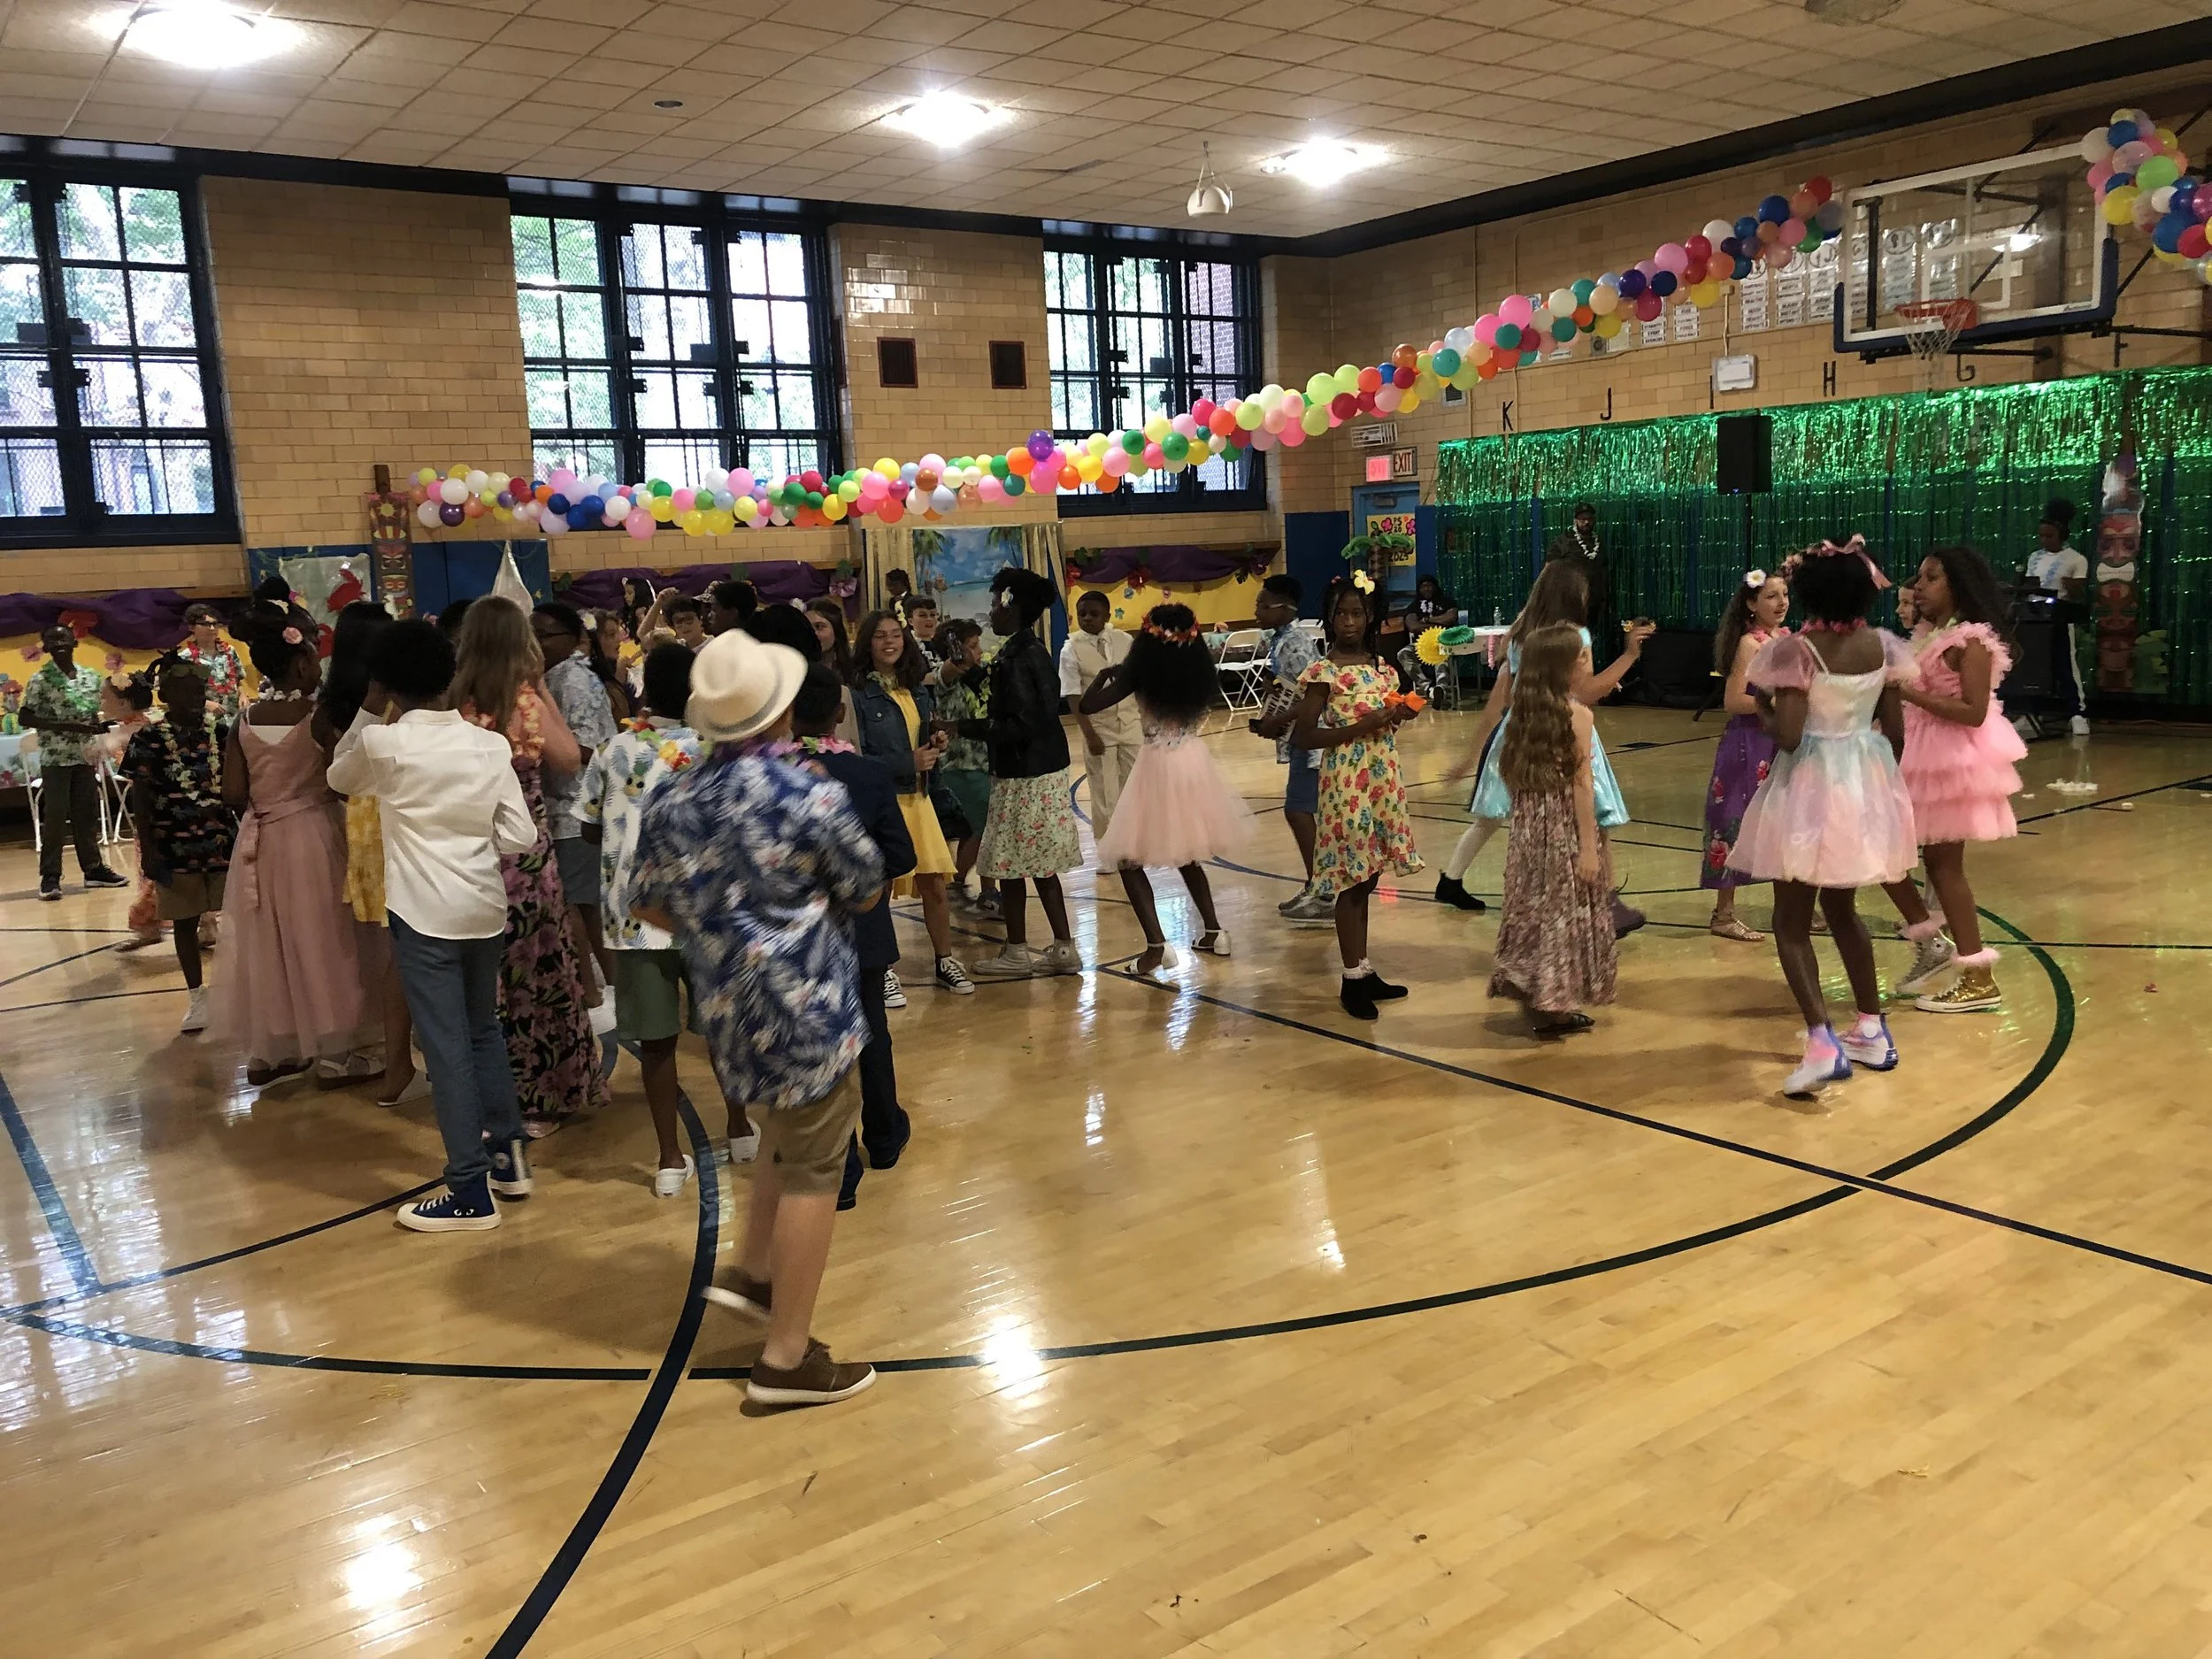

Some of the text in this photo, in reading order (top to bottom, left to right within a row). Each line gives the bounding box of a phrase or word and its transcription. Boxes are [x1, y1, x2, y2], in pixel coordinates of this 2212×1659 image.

[1823, 361, 1837, 397] H
[1502, 400, 1514, 432] K
[1600, 387, 1612, 421] J
[1393, 452, 1411, 472] EXIT
